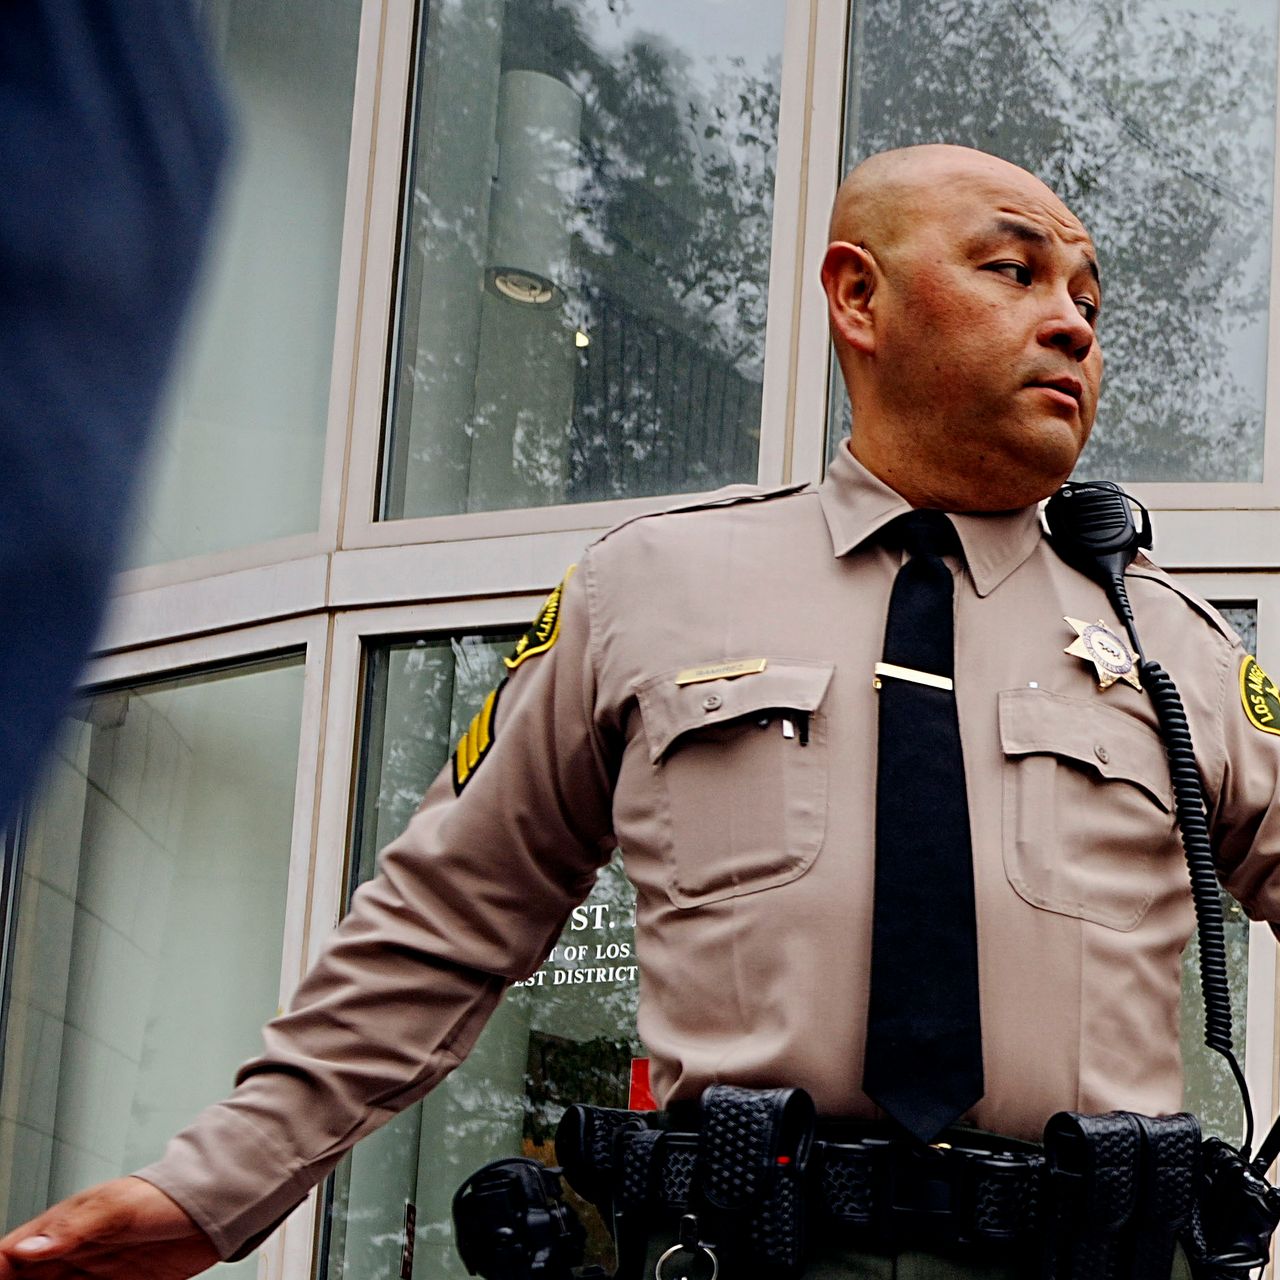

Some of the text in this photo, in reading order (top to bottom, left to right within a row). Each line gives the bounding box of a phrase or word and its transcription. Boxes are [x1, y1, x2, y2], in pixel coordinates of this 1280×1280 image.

[570, 904, 615, 931] ST.
[563, 945, 588, 961] OF
[596, 942, 631, 960] LOS
[553, 965, 638, 985] DISTRICT
